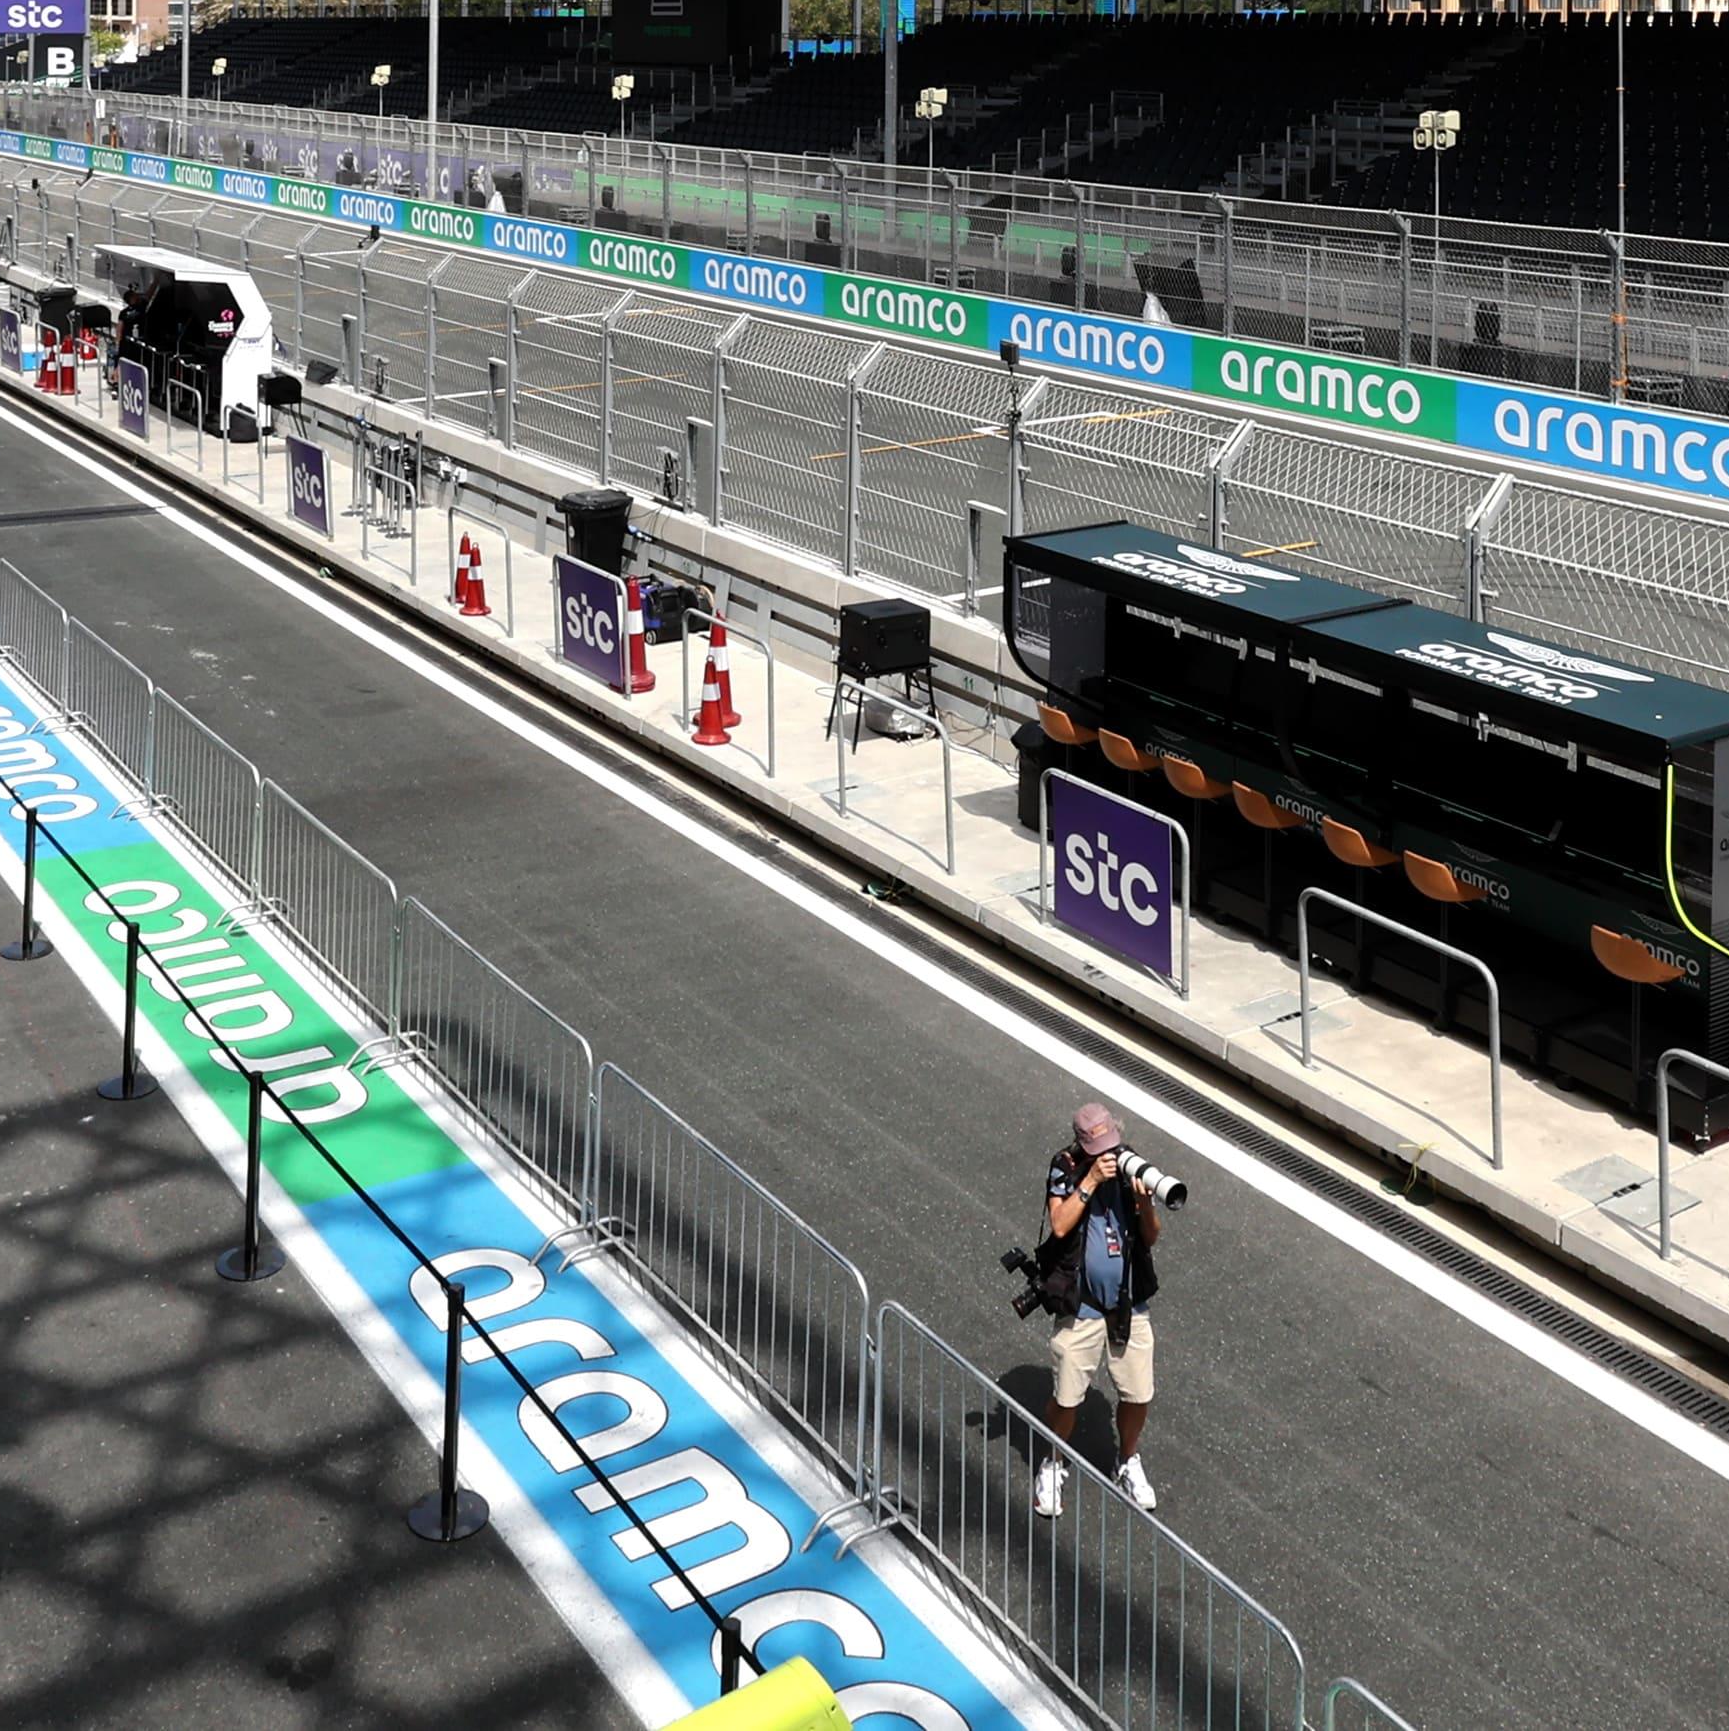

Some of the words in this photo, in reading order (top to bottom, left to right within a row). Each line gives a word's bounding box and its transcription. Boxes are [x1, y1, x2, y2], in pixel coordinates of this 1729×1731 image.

[7, 0, 64, 28] stc
[48, 47, 75, 75] B
[57, 139, 85, 163] aramco
[93, 146, 122, 171] aramco
[131, 157, 165, 180] aramco
[175, 160, 212, 189] aramco
[223, 173, 266, 199] aramco
[278, 176, 326, 211] aramco
[340, 192, 395, 225] aramco
[411, 204, 474, 241] aramco
[493, 221, 566, 260] aramco
[589, 238, 675, 281] aramco
[705, 257, 807, 306] aramco
[841, 281, 967, 337] aramco
[1010, 312, 1165, 376] aramco
[121, 375, 146, 417] stc
[1220, 349, 1422, 425] aramco
[293, 455, 323, 509] stc
[1112, 552, 1247, 594] aramco
[566, 591, 615, 655] stc
[1418, 643, 1599, 699] aramco
[1521, 687, 1572, 705] TEAM
[1065, 831, 1159, 928] stc
[83, 879, 369, 1125] aramco
[408, 1248, 972, 1731] aramc
